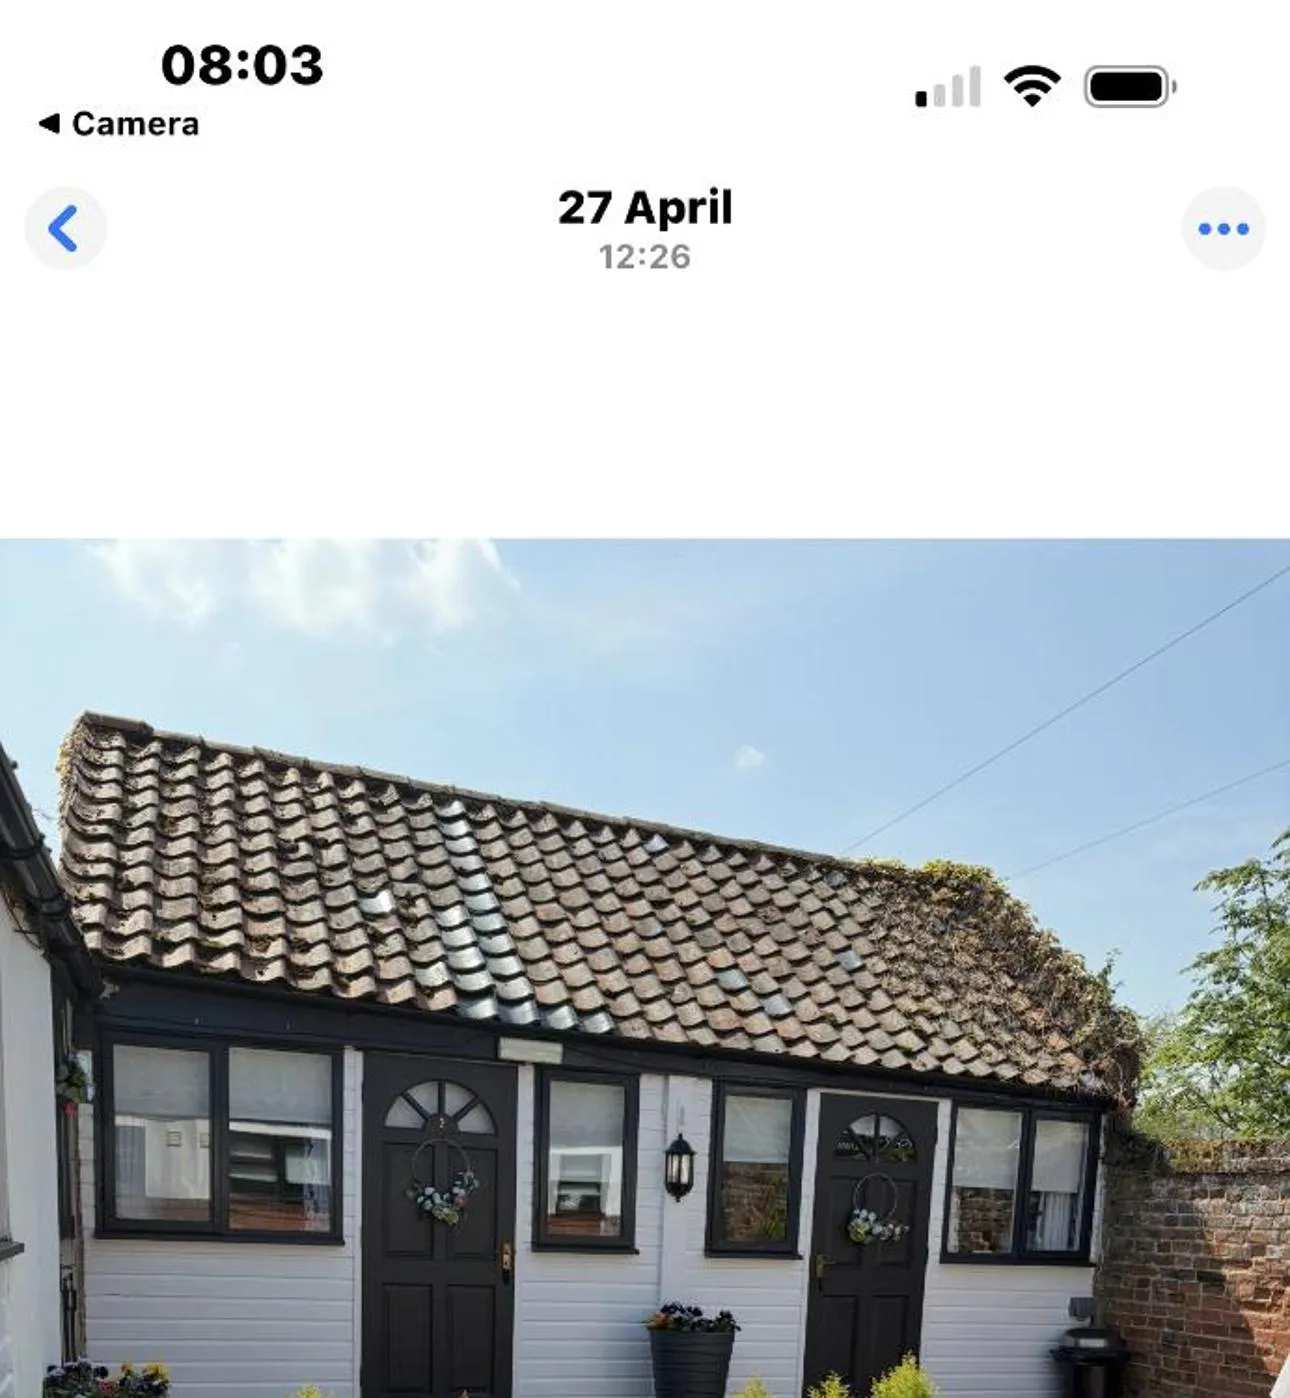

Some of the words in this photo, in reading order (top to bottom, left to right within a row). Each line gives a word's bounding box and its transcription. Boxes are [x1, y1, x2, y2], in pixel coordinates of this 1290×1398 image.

[161, 43, 324, 87] 08:03
[71, 109, 200, 137] Camera
[558, 189, 613, 225] 27
[623, 187, 732, 233] April
[599, 243, 691, 270] 12:26
